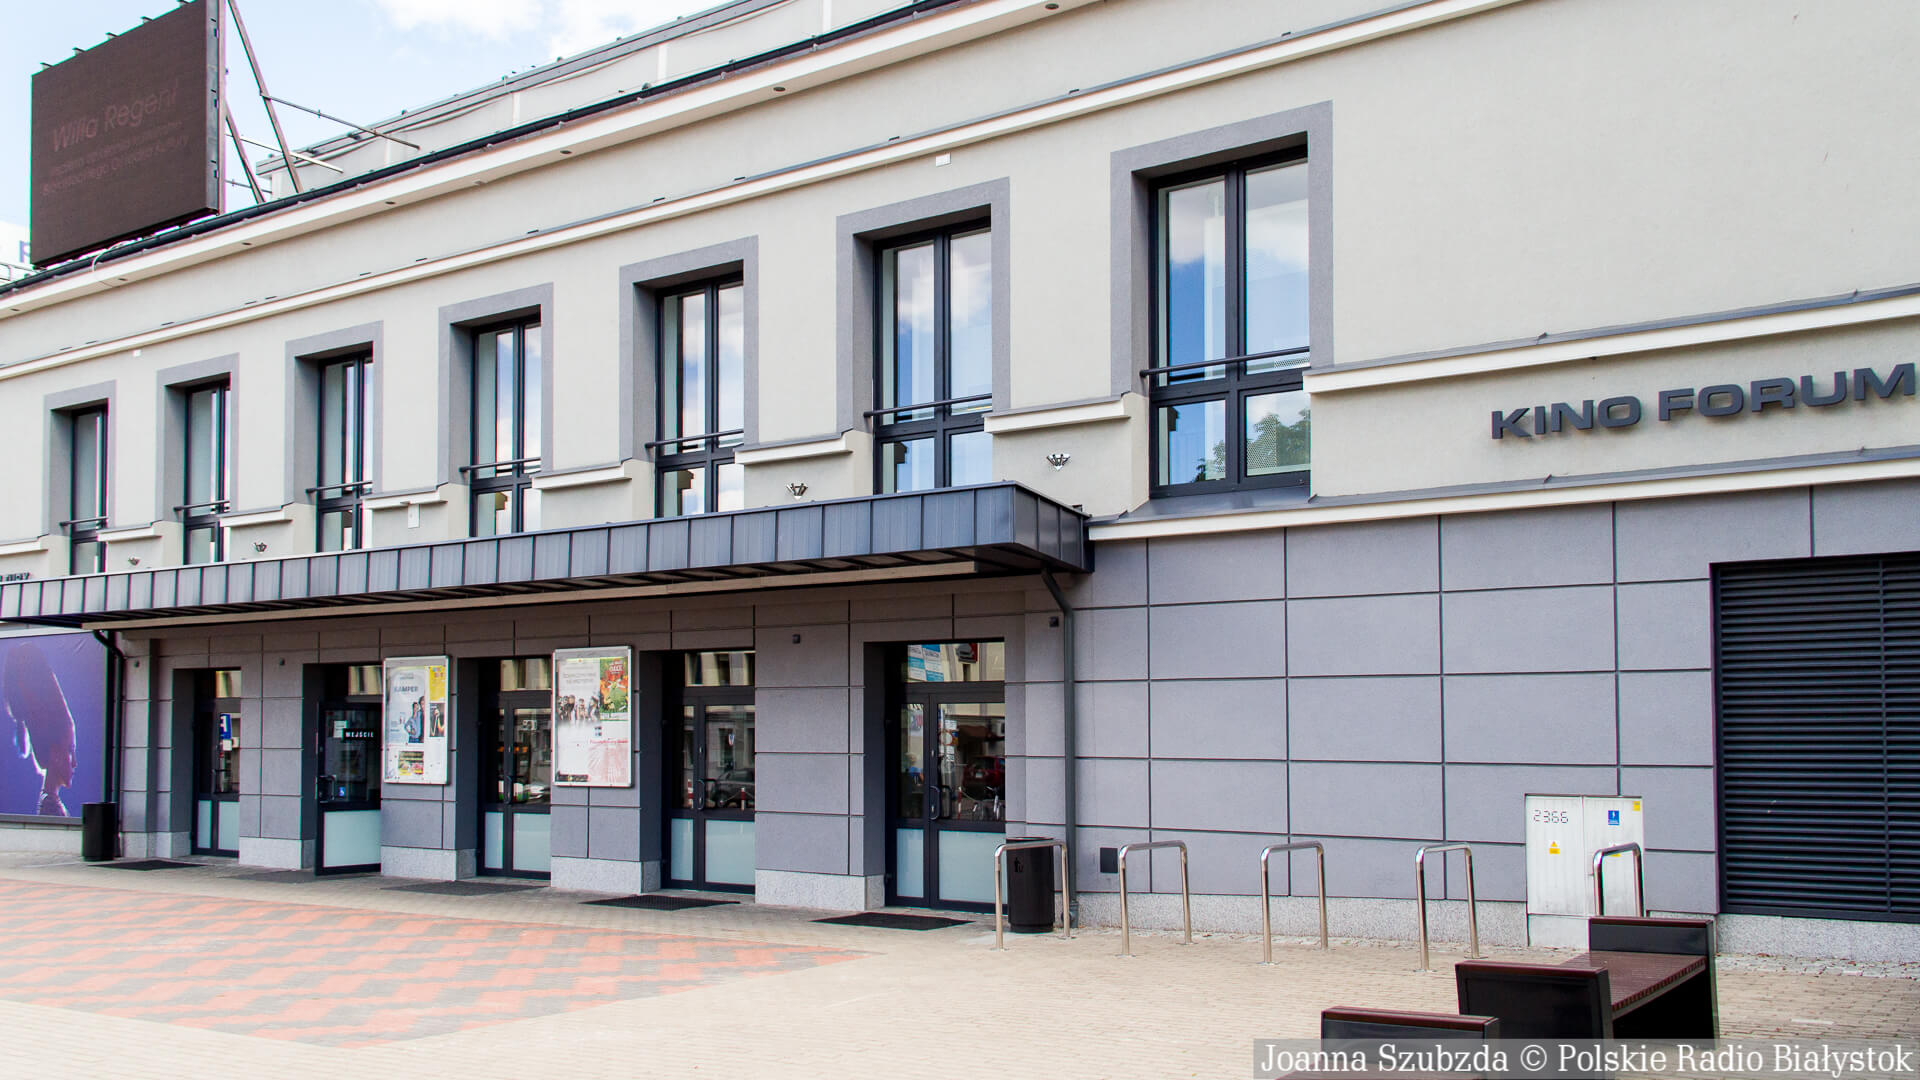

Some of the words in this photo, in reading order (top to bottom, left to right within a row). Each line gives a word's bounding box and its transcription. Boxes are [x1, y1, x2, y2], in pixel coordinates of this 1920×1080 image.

[53, 117, 98, 153] Willa
[103, 78, 178, 133] Regent
[1491, 395, 1642, 440] KINO
[1658, 362, 1916, 422] FORUM
[1533, 809, 1569, 824] 2366
